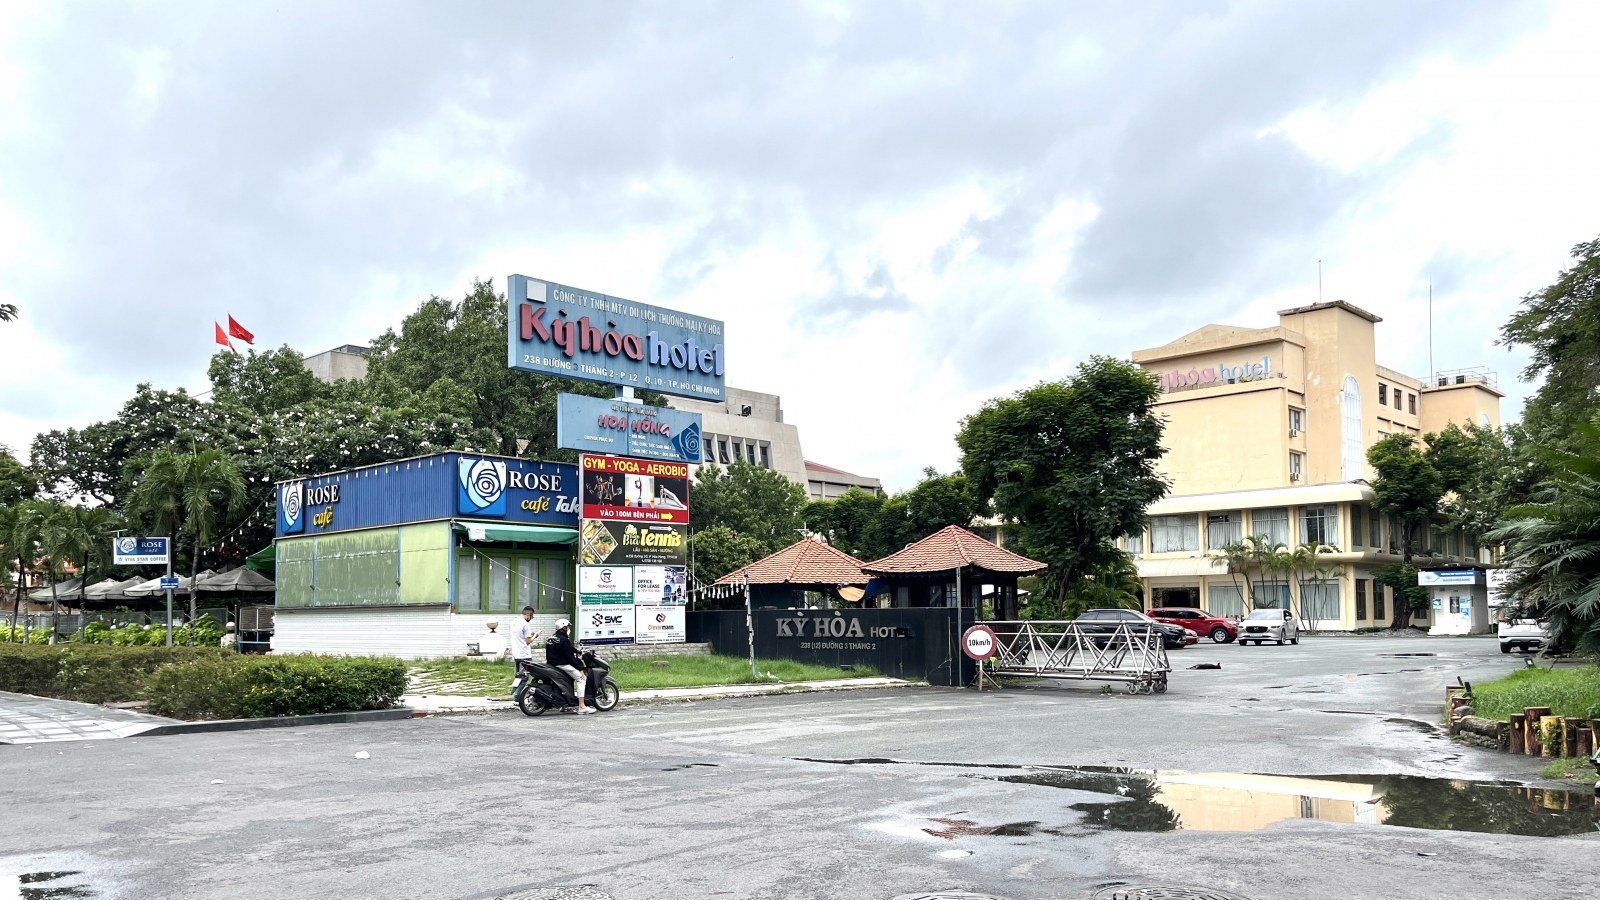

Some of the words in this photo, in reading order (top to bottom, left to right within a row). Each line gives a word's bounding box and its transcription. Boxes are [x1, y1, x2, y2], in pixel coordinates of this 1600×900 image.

[553, 288, 575, 304] CÔNG
[578, 294, 588, 307] TY
[590, 298, 610, 312] TNHH
[611, 302, 628, 315] MTV
[629, 306, 639, 317] DU
[640, 309, 656, 323] LỊCH
[646, 330, 725, 376] hotel
[524, 354, 541, 365] 238
[580, 364, 608, 377] THÁNG
[608, 369, 615, 378] 2
[620, 371, 626, 380] P
[629, 373, 638, 382] 12
[703, 386, 720, 396] MINH
[1218, 355, 1271, 381] hotel
[598, 414, 628, 433] HOA
[631, 416, 671, 438] HỒNG
[583, 457, 606, 469] GYM
[613, 460, 640, 473] YOGA
[646, 464, 688, 476] AEROBIC
[508, 470, 562, 492] ROSE
[306, 484, 339, 506] ROSE
[521, 496, 550, 514] café
[600, 508, 614, 517] VÀO
[616, 510, 631, 518] 100M
[633, 510, 644, 518] BÊN
[640, 528, 681, 546] Tennis
[604, 615, 623, 624] SMC
[776, 611, 809, 637] KỲ
[813, 610, 865, 638] HÒA
[849, 641, 870, 650] THÁNG
[968, 639, 991, 647] 10km/h
